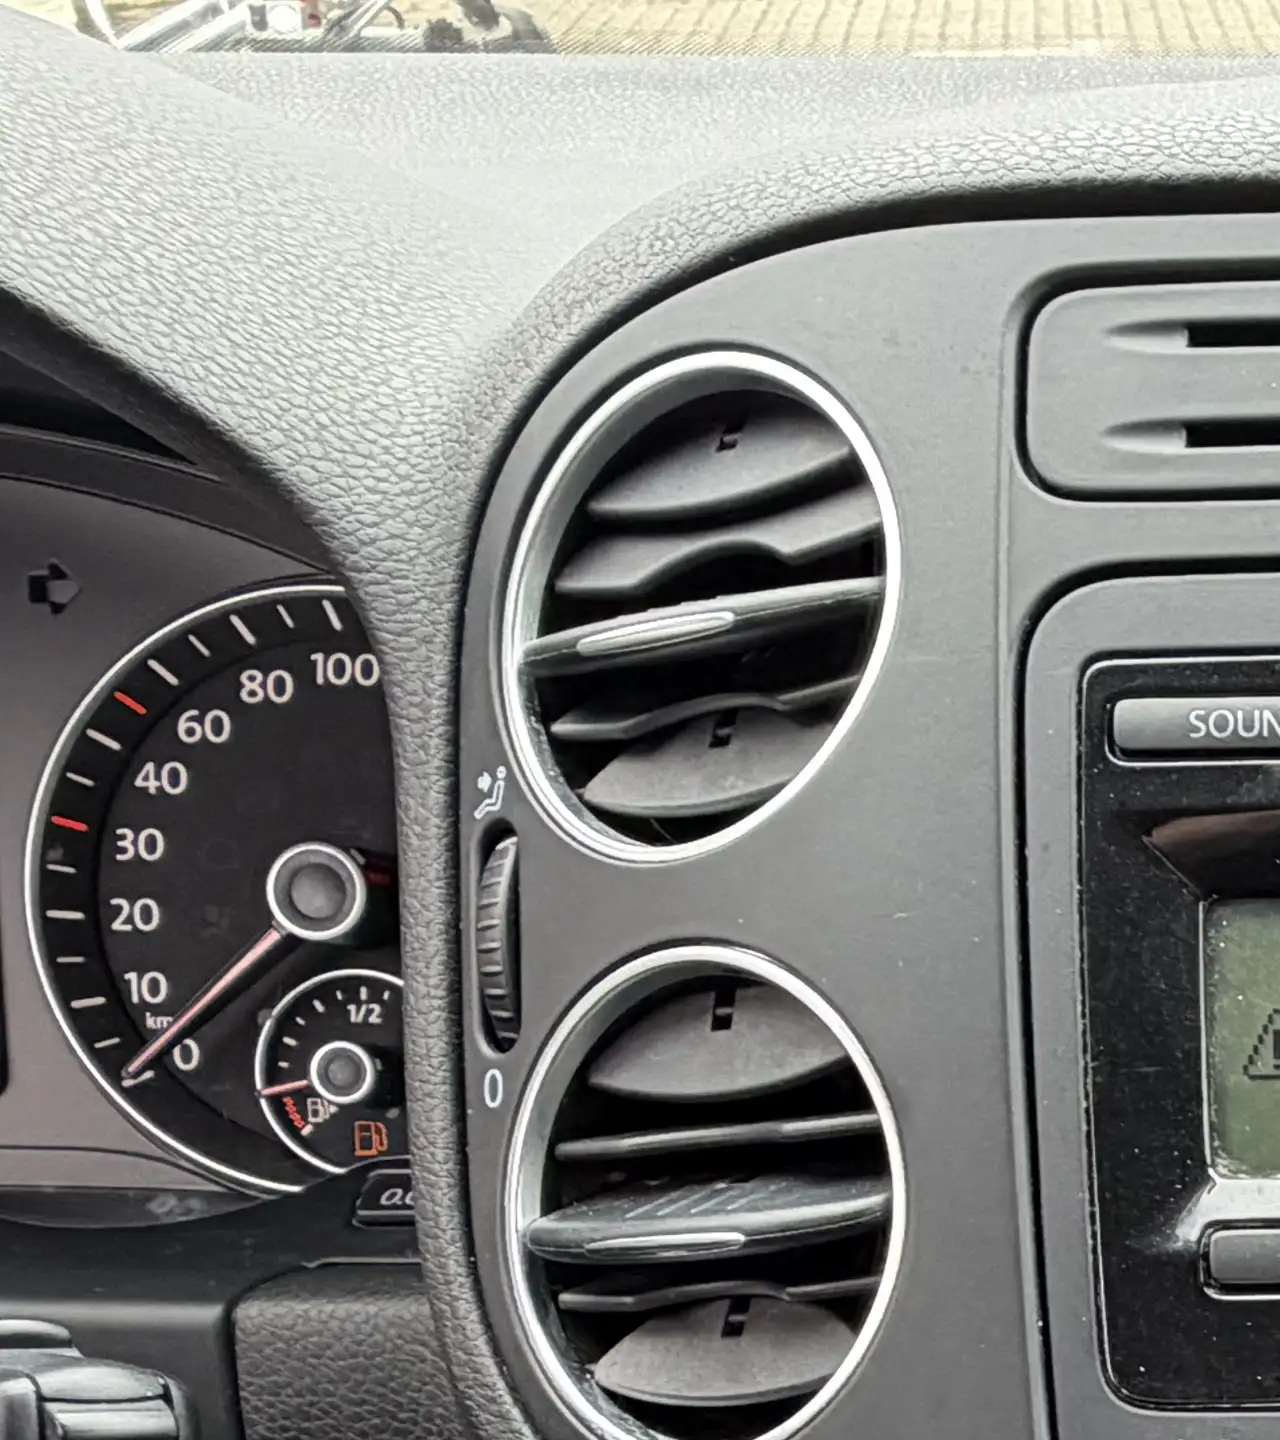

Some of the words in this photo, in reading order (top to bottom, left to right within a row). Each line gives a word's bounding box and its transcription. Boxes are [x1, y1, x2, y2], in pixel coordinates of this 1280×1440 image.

[239, 669, 295, 704] 80
[310, 653, 380, 687] 100
[176, 708, 232, 744] 60
[133, 761, 189, 796] 40
[114, 827, 165, 862] 30
[109, 897, 161, 933] 20
[123, 970, 169, 1005] 10
[346, 1003, 384, 1025] 1/2
[172, 1037, 200, 1072] 0
[483, 1068, 503, 1109] 0
